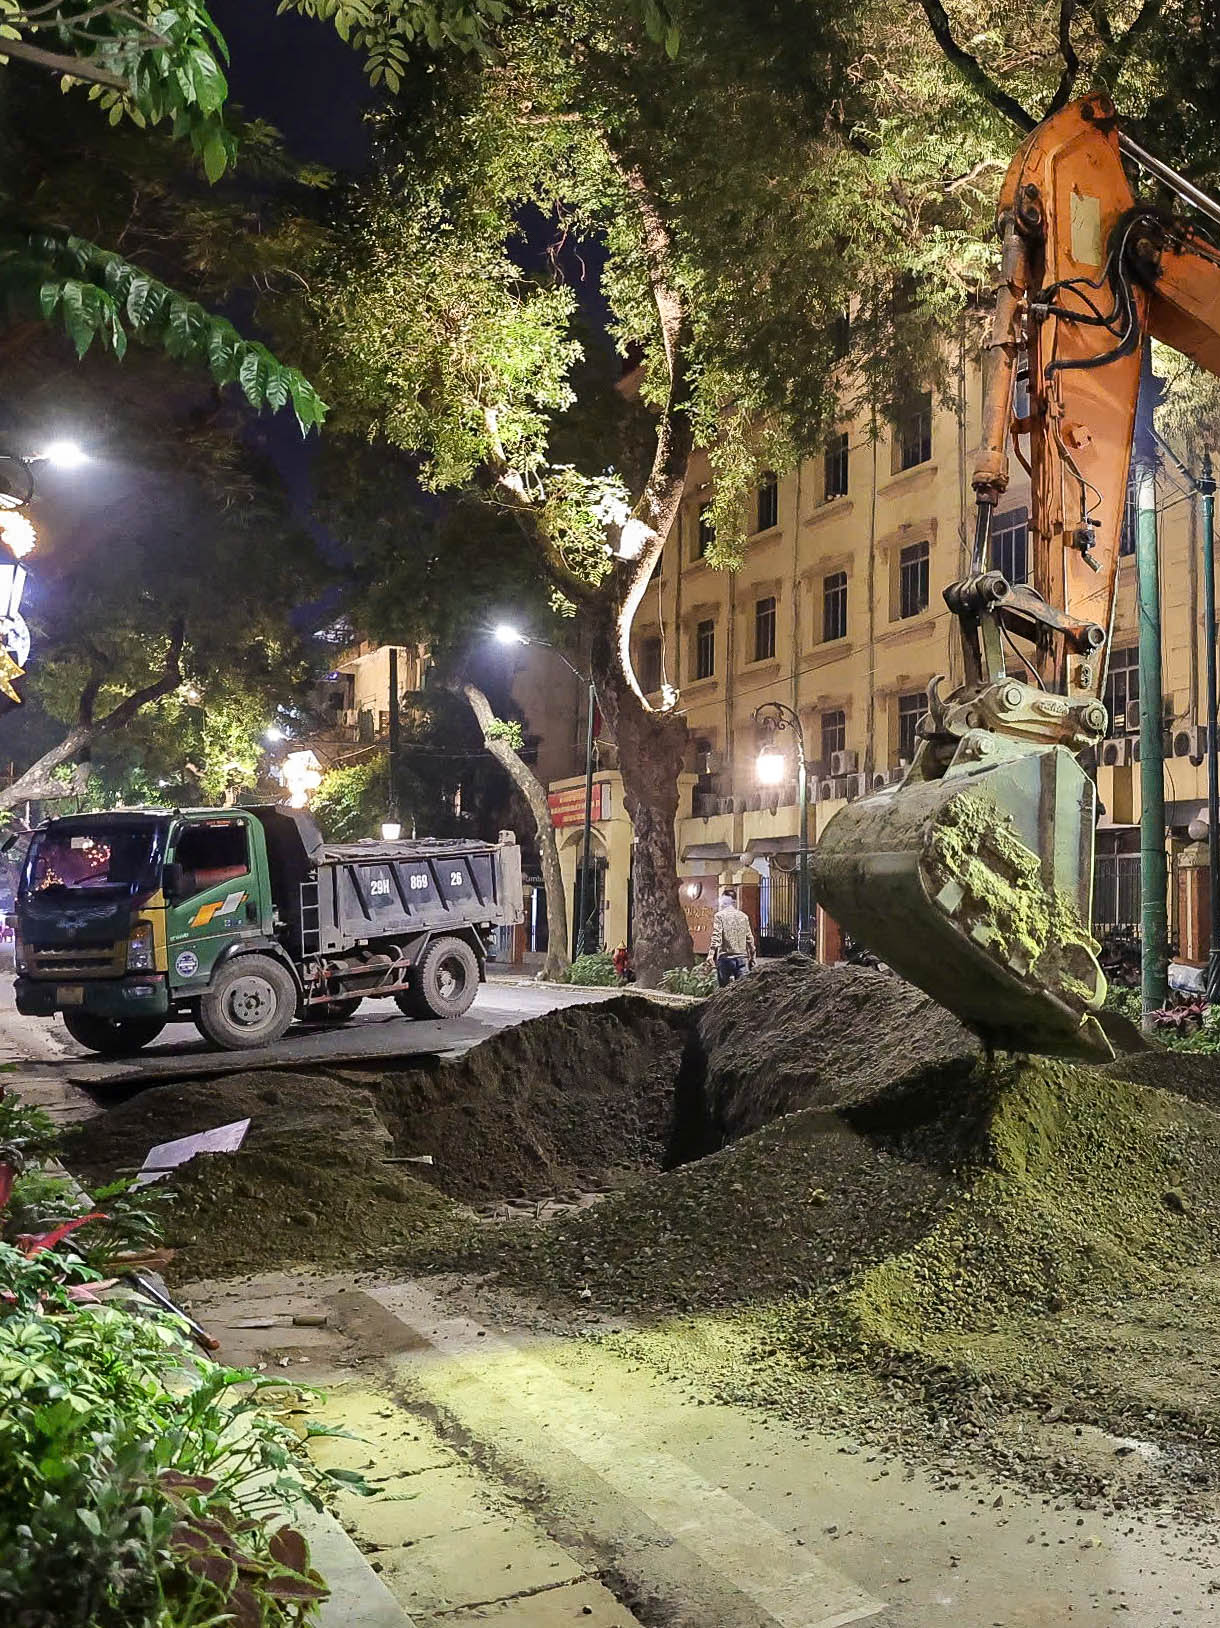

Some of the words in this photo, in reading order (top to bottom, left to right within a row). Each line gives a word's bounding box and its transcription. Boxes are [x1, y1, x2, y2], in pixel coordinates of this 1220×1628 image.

[370, 879, 390, 895] 29H
[410, 874, 428, 889] 869
[450, 871, 462, 886] 26
